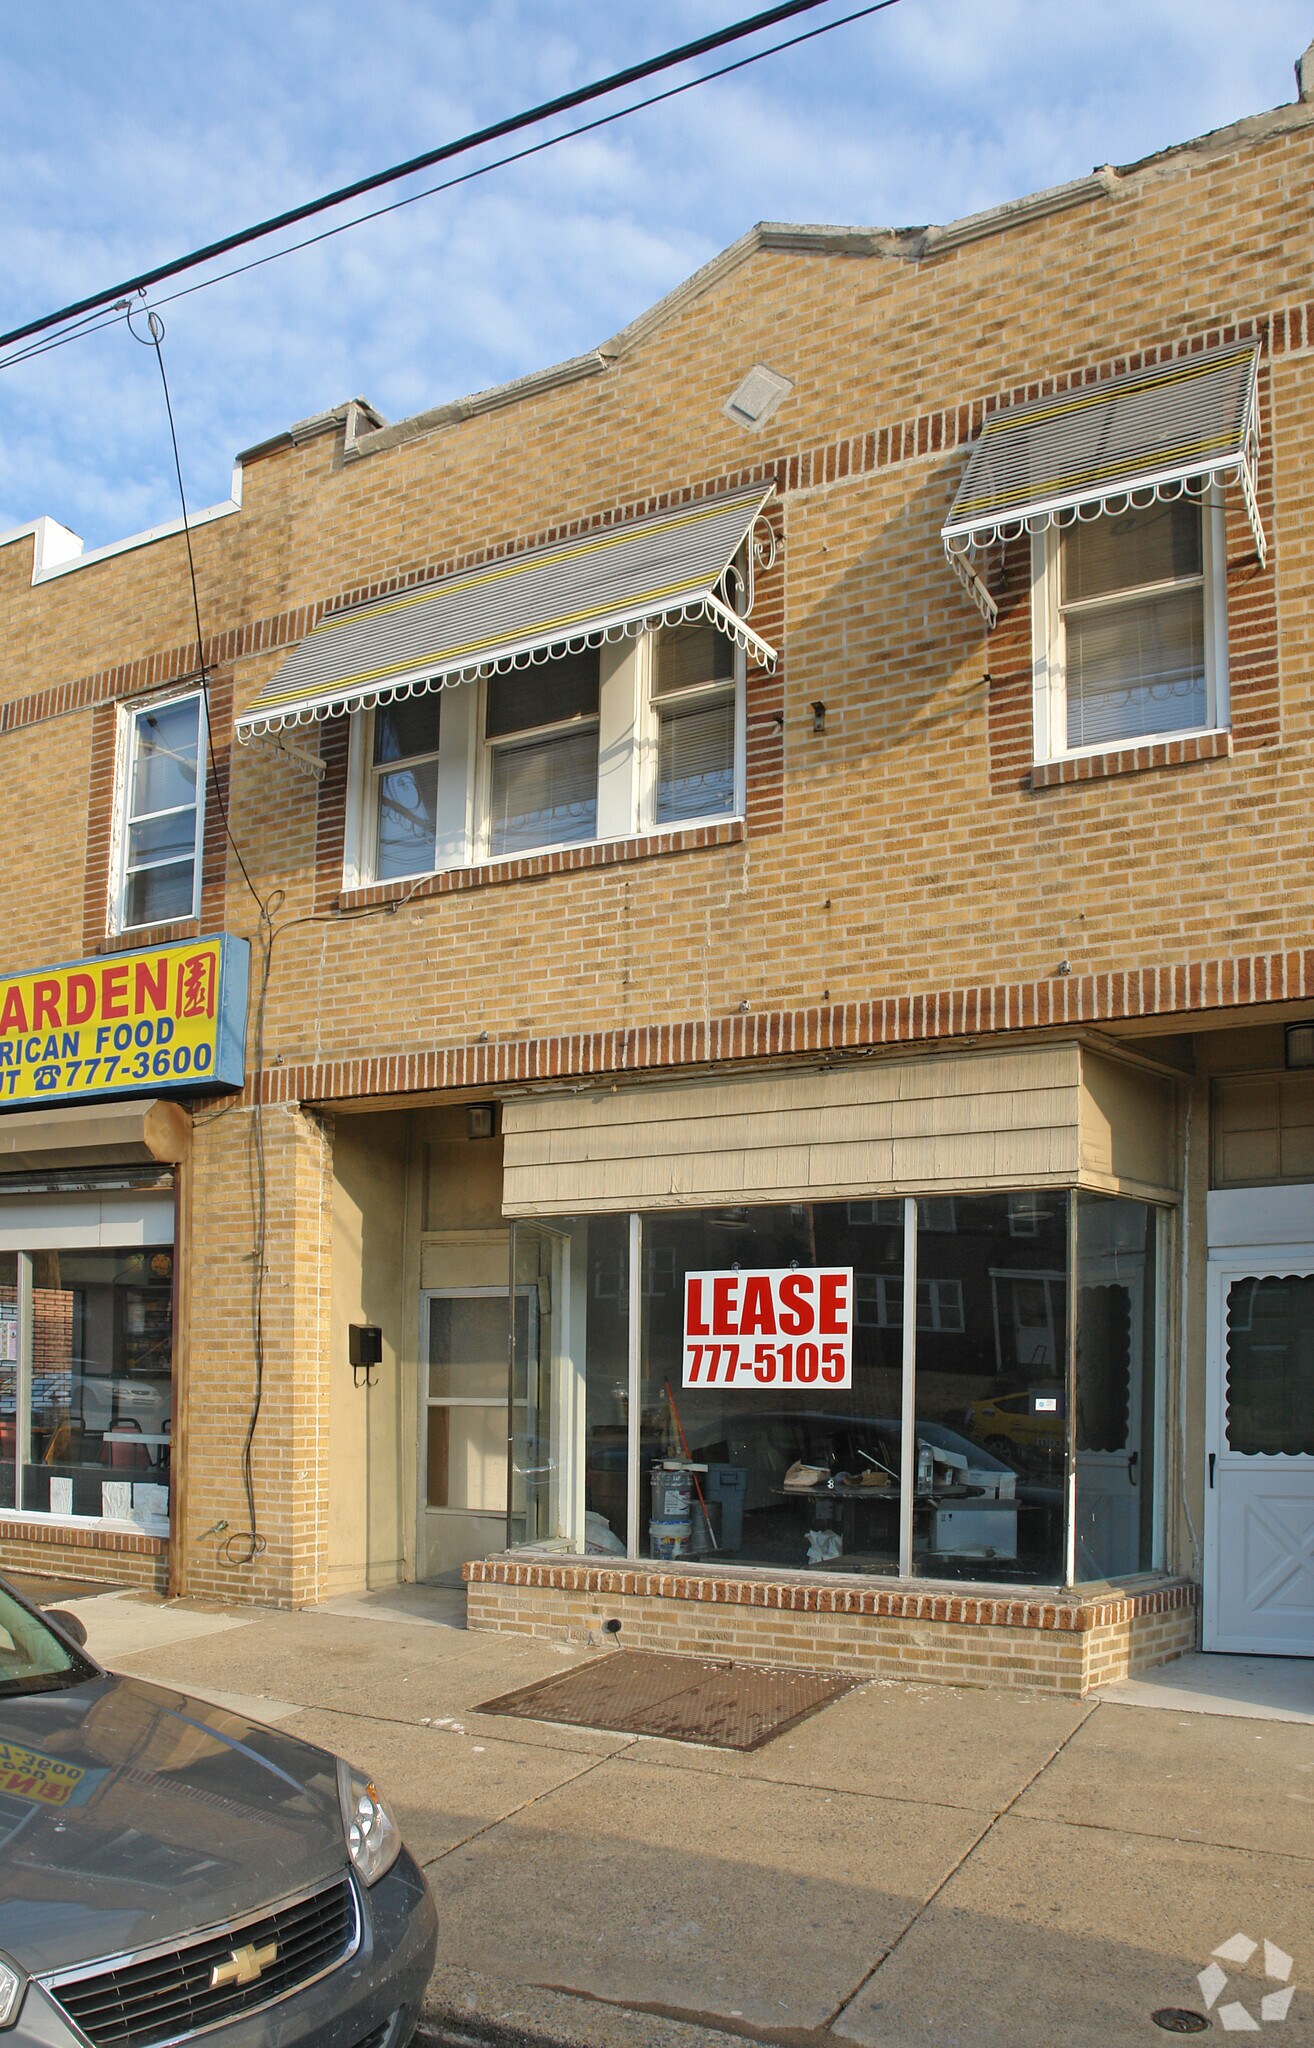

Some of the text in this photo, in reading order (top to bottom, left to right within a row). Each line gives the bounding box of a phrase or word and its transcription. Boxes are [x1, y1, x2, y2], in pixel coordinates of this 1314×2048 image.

[0, 957, 168, 1036] ARDEN
[0, 1016, 174, 1067] RICAN FOOD
[66, 1043, 212, 1087] 777-3600
[686, 1274, 848, 1336] LEASE
[687, 1342, 845, 1383] 777-5105
